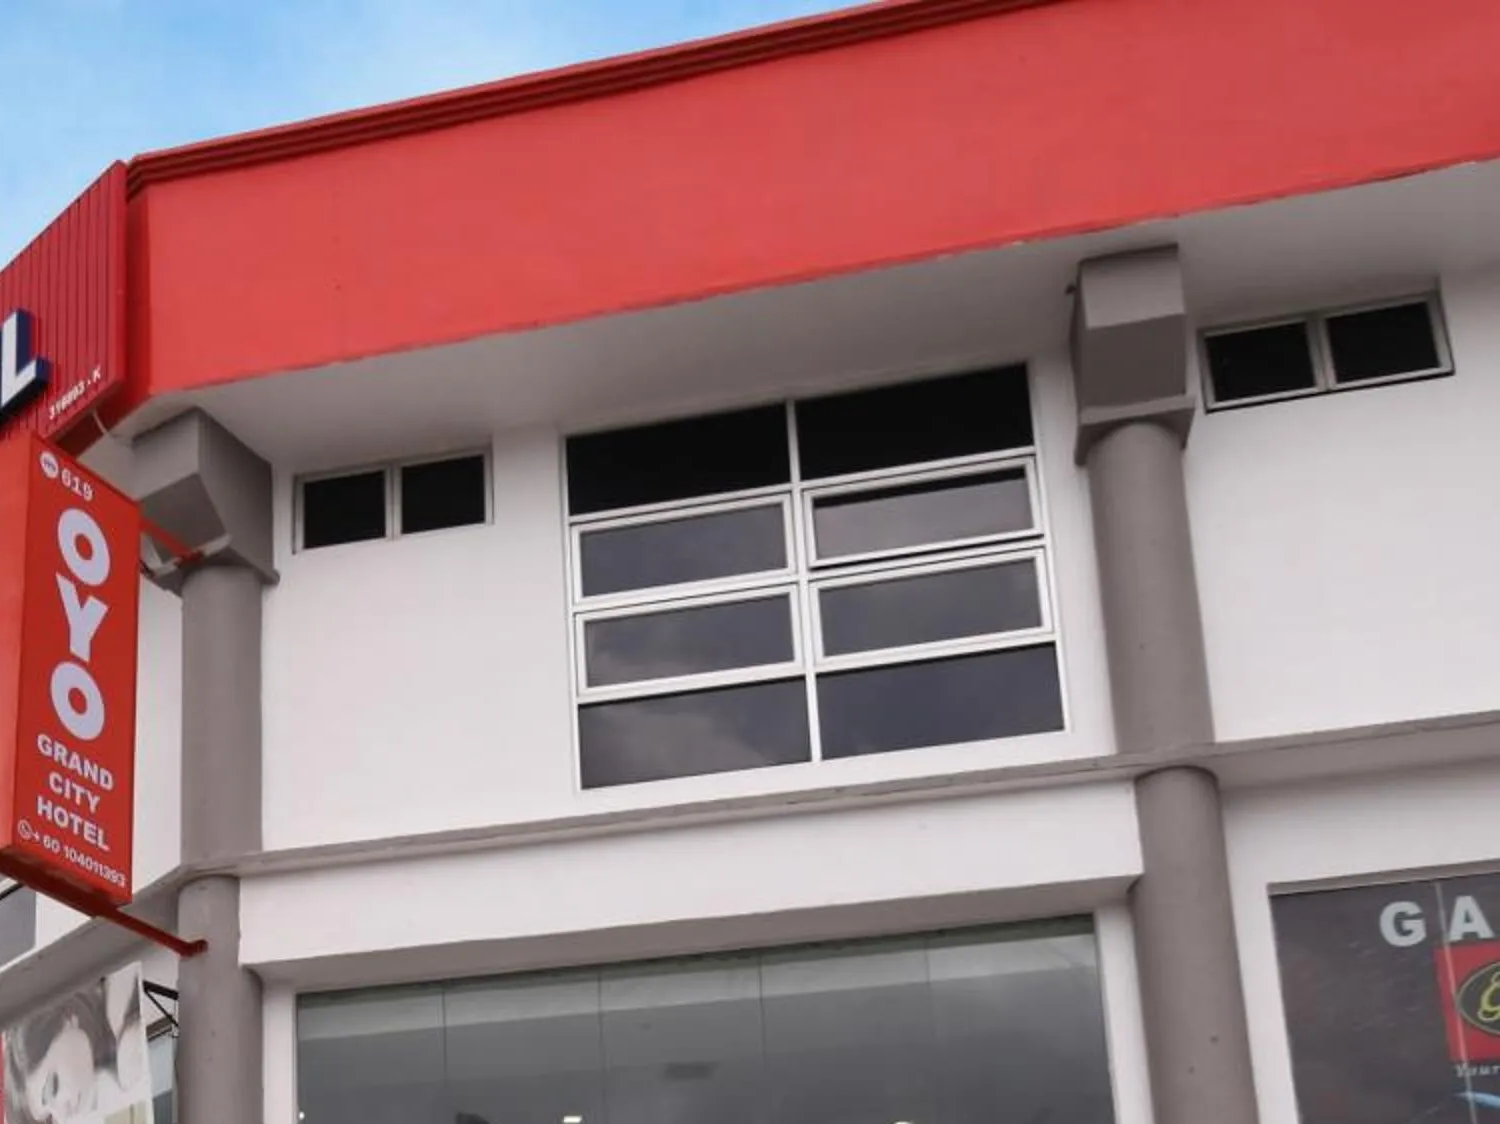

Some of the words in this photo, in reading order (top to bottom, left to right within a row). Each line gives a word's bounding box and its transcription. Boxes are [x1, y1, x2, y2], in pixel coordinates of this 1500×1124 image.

[61, 468, 93, 502] 619
[50, 508, 110, 740] OYO
[37, 734, 114, 790] GRAND
[49, 772, 100, 814] CITY
[37, 796, 110, 851] HOTEL
